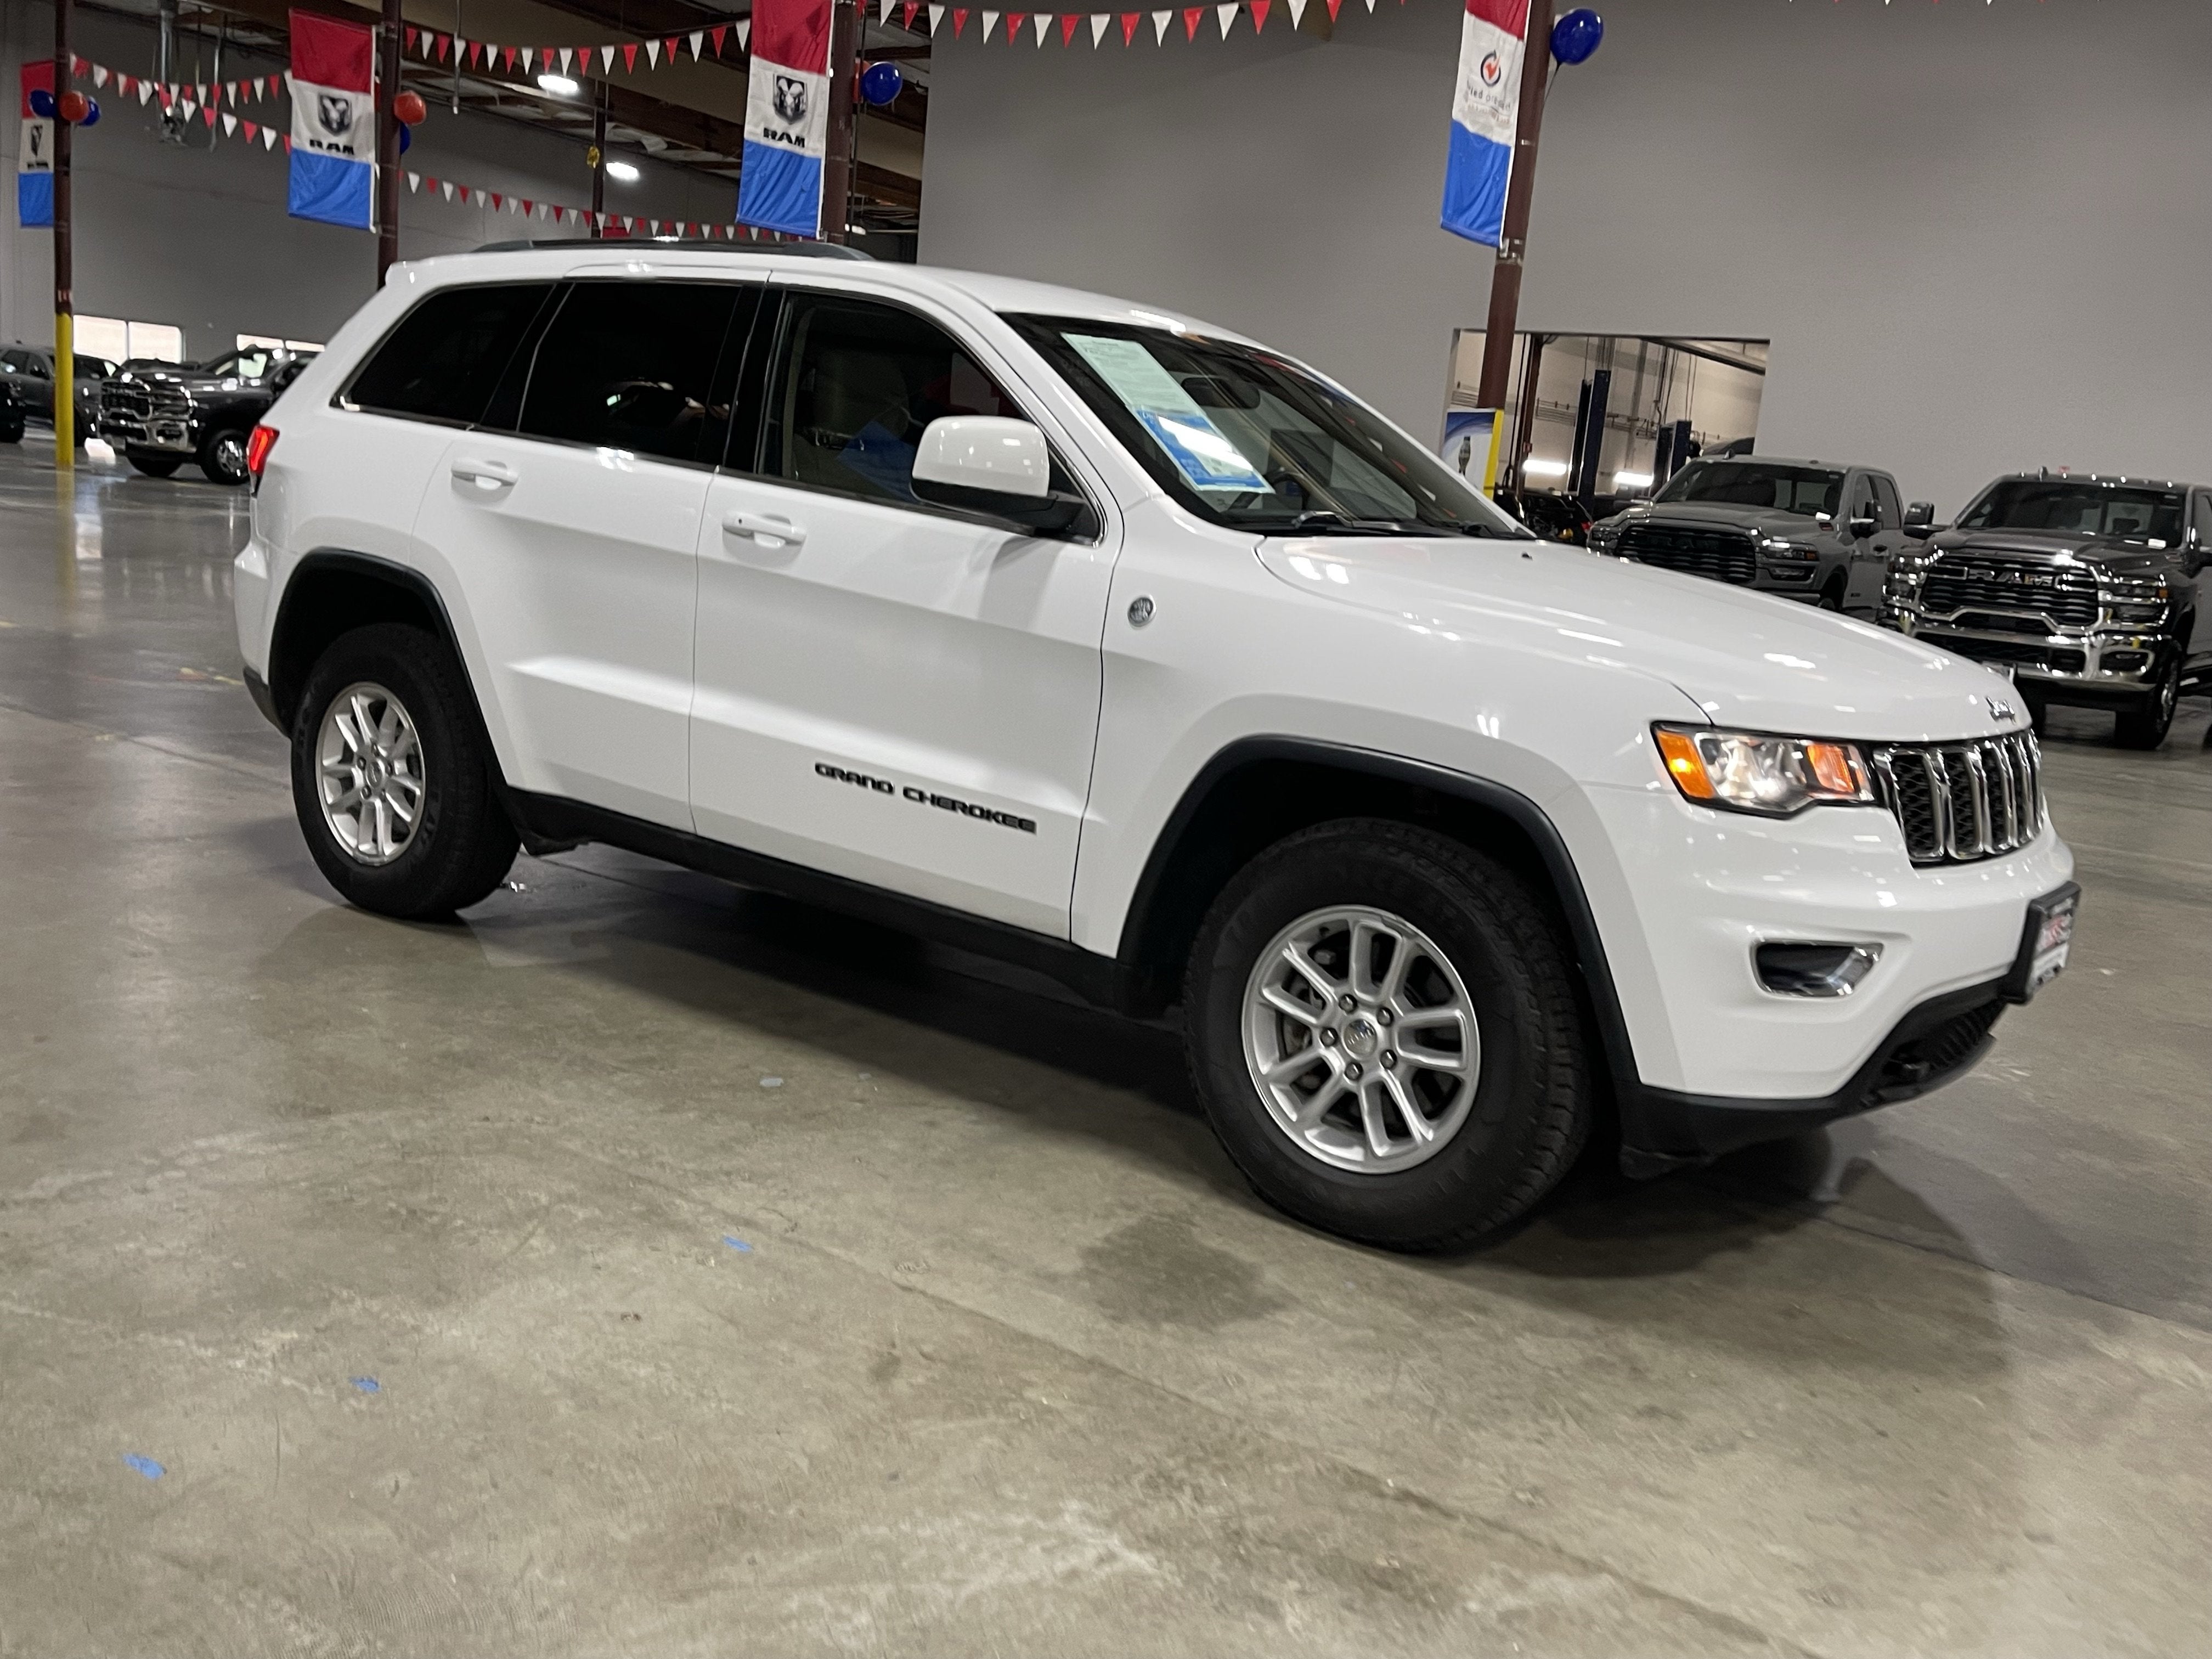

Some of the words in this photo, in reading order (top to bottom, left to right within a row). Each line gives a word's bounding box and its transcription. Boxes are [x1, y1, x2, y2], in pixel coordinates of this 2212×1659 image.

[309, 139, 354, 155] RAM
[763, 127, 805, 148] RAM
[815, 763, 895, 794] GRAND
[903, 786, 1037, 835] CHEROKEE
